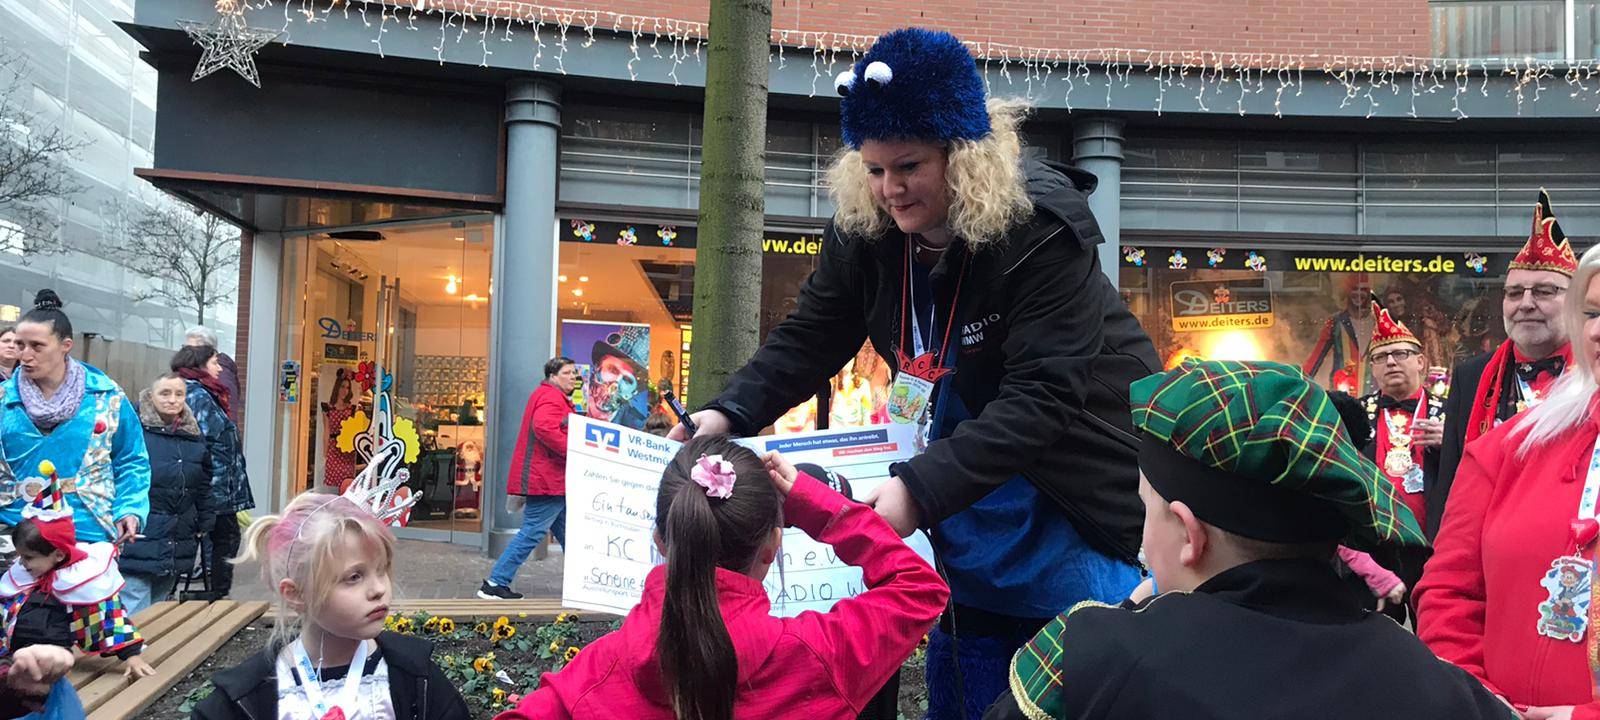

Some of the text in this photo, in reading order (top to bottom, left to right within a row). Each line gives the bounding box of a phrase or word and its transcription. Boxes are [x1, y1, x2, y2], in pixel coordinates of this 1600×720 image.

[1295, 254, 1455, 272] www.deiters.de
[1179, 315, 1269, 329] www.deiters.de
[628, 434, 671, 453] VR-Bank
[607, 535, 635, 561] KC
